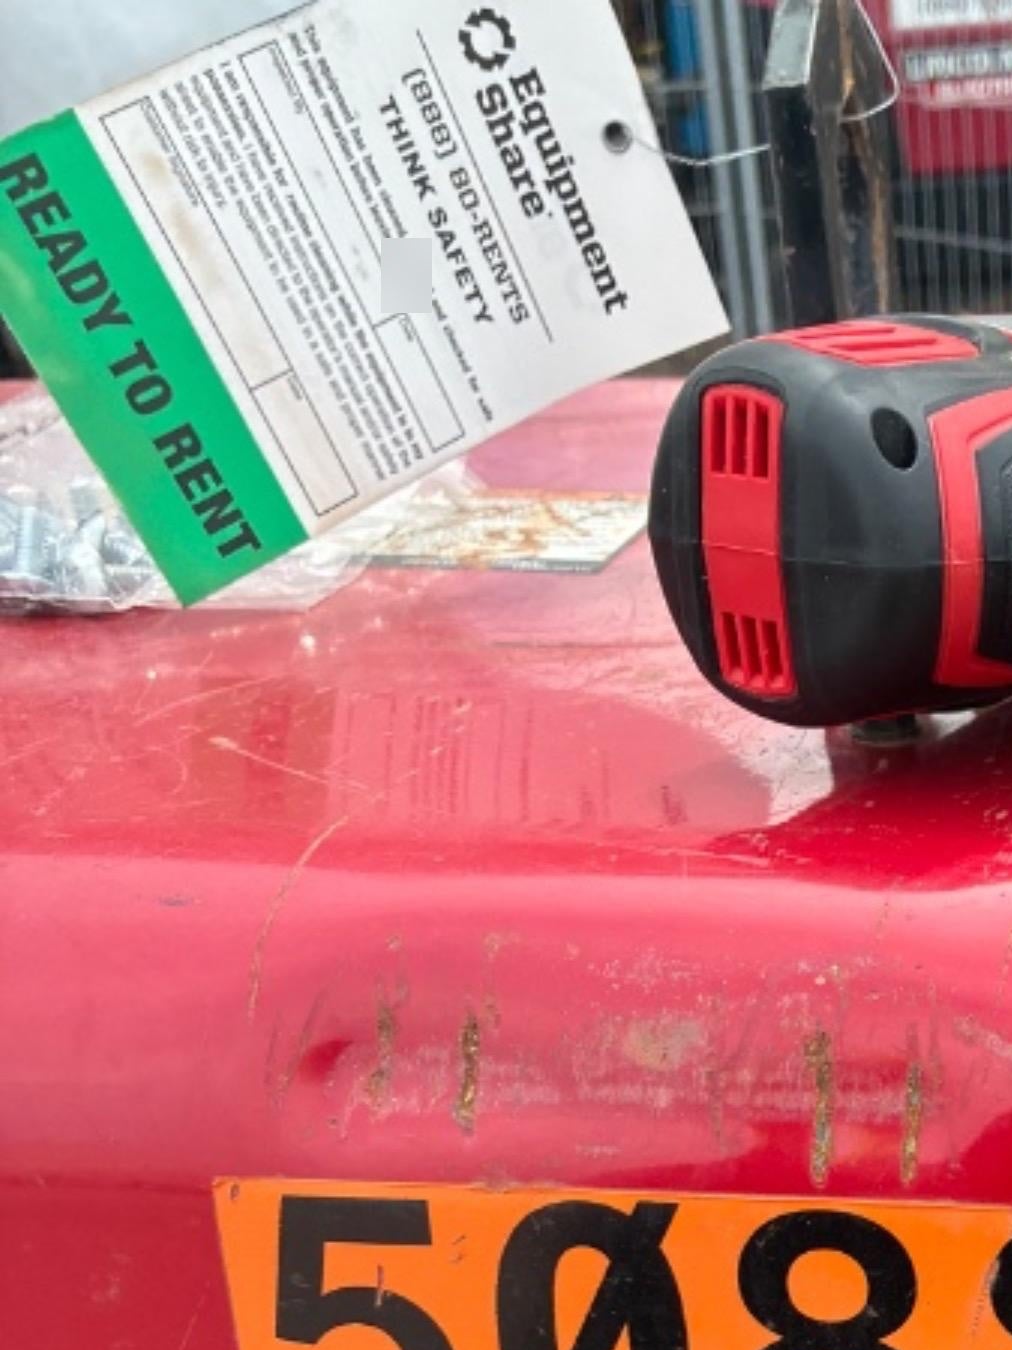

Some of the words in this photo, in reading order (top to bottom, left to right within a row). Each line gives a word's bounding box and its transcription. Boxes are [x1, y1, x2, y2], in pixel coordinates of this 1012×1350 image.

[375, 94, 437, 203] THINK
[425, 204, 494, 329] SAFETY
[400, 64, 459, 162] (888)
[447, 164, 530, 326] 80-RENTS
[472, 79, 551, 221] Share
[503, 64, 630, 322] Equipment
[0, 151, 131, 339] READY
[103, 339, 176, 419] TO
[151, 421, 261, 566] RENT
